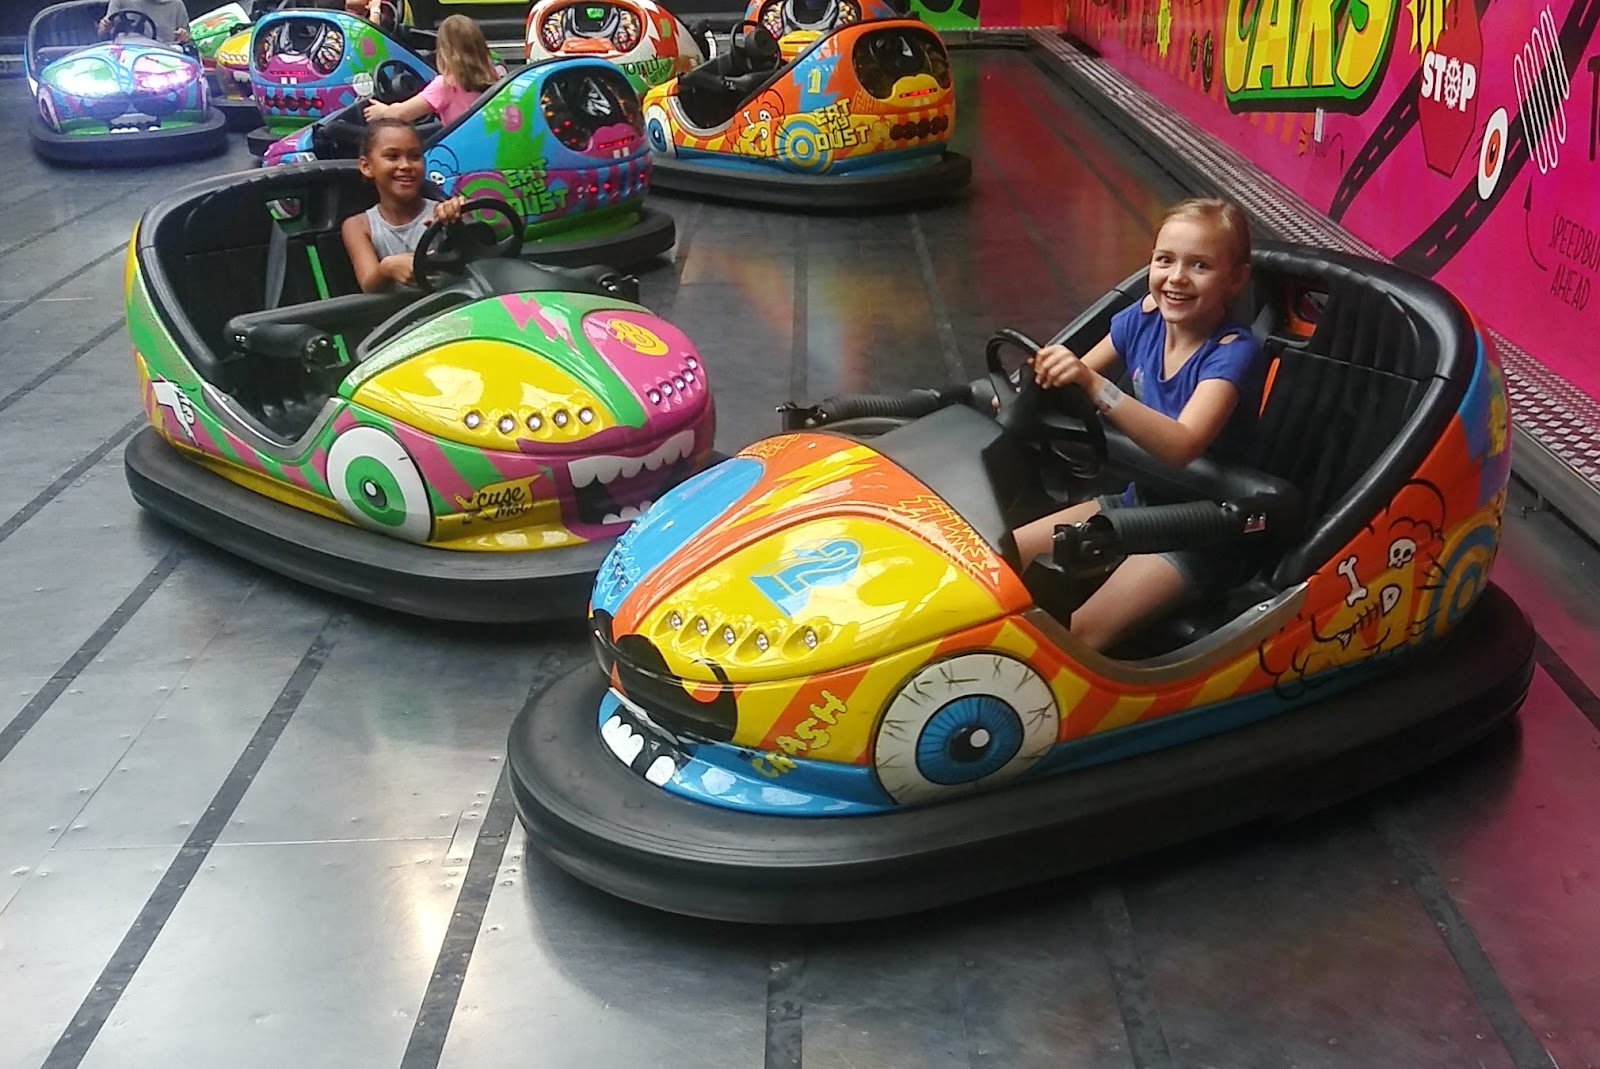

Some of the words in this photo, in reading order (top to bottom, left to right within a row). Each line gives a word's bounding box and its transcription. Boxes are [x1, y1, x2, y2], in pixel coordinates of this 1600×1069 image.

[1224, 0, 1393, 93] CARS
[807, 68, 822, 94] 1
[1421, 50, 1476, 112] STOP
[813, 98, 850, 126] EAT
[829, 115, 850, 132] MY
[814, 125, 870, 152] DUST
[502, 158, 547, 188] EAT
[1550, 263, 1592, 312] AHEAD
[749, 538, 863, 617] 12
[752, 689, 848, 778] CRASH
